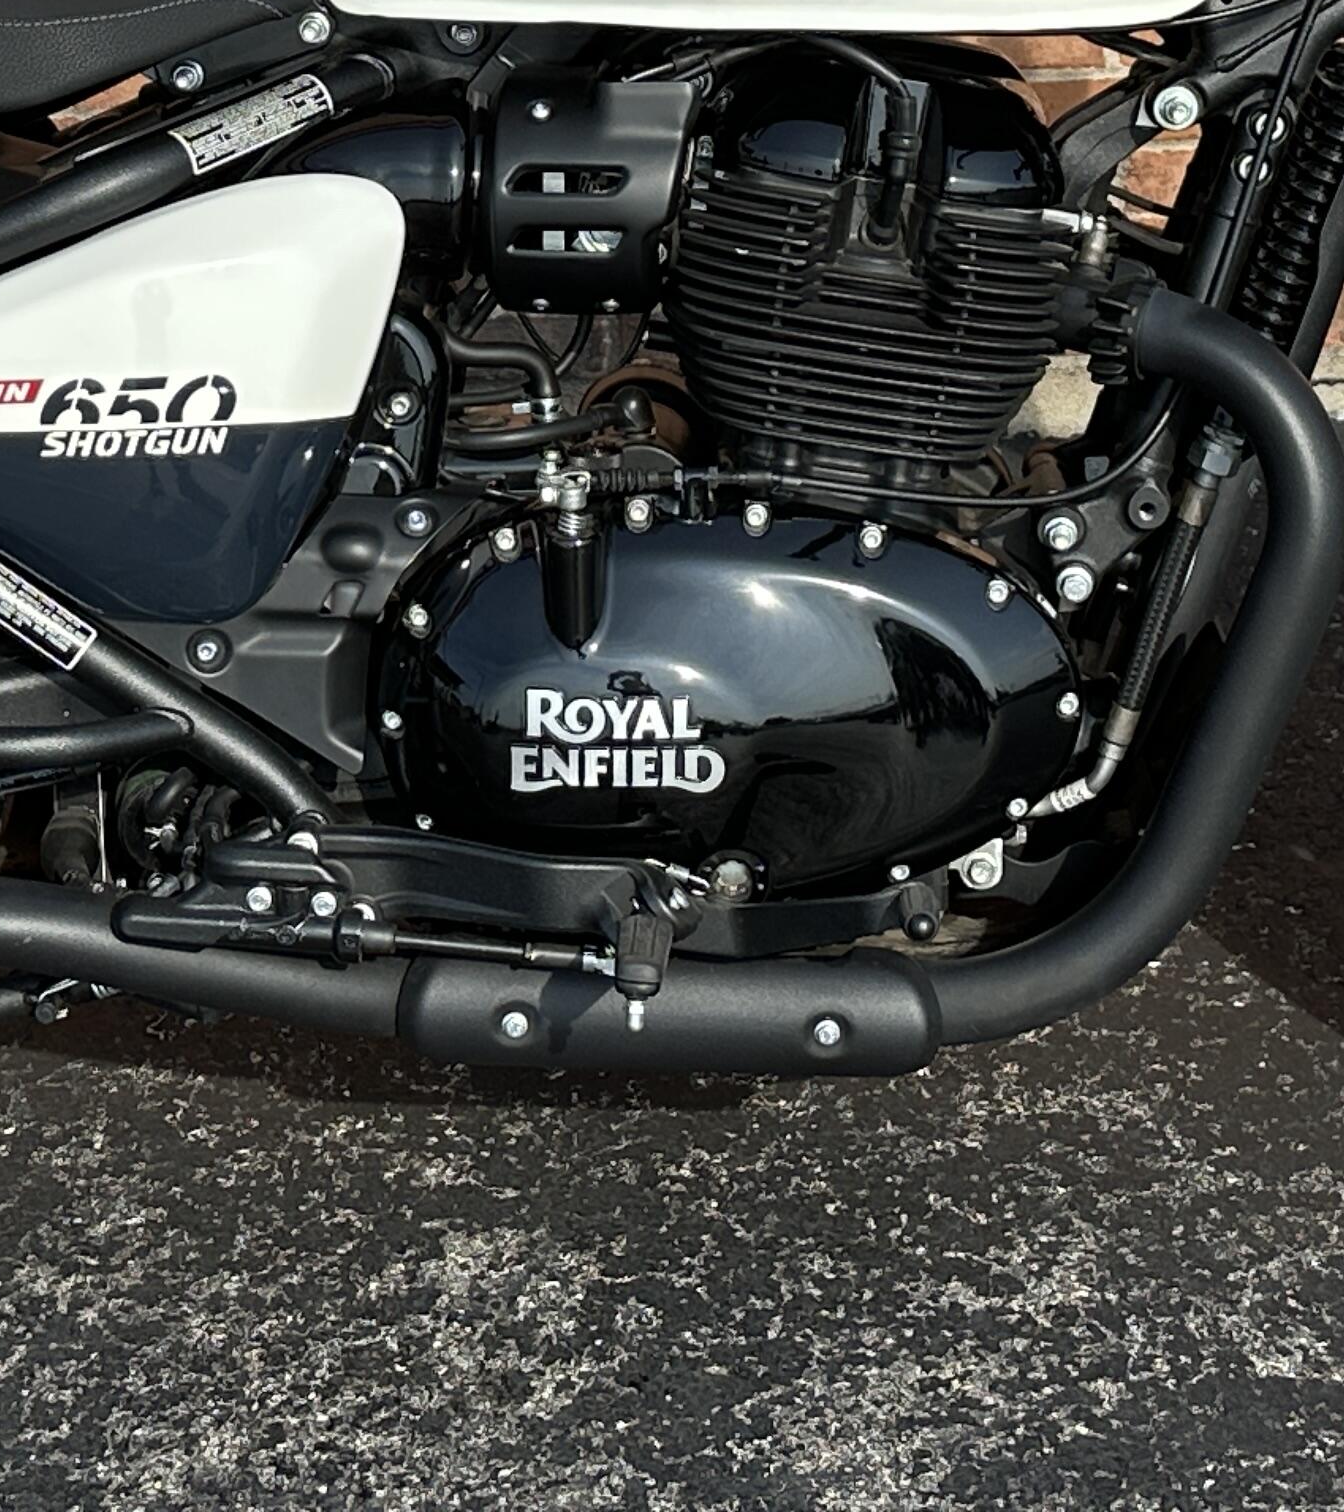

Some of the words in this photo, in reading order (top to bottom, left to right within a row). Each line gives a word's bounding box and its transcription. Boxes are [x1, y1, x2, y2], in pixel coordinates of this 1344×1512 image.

[40, 374, 238, 425] 650
[40, 426, 229, 458] SHOTGUN
[526, 688, 701, 742] ROYAL
[510, 745, 726, 793] ENFIELD
